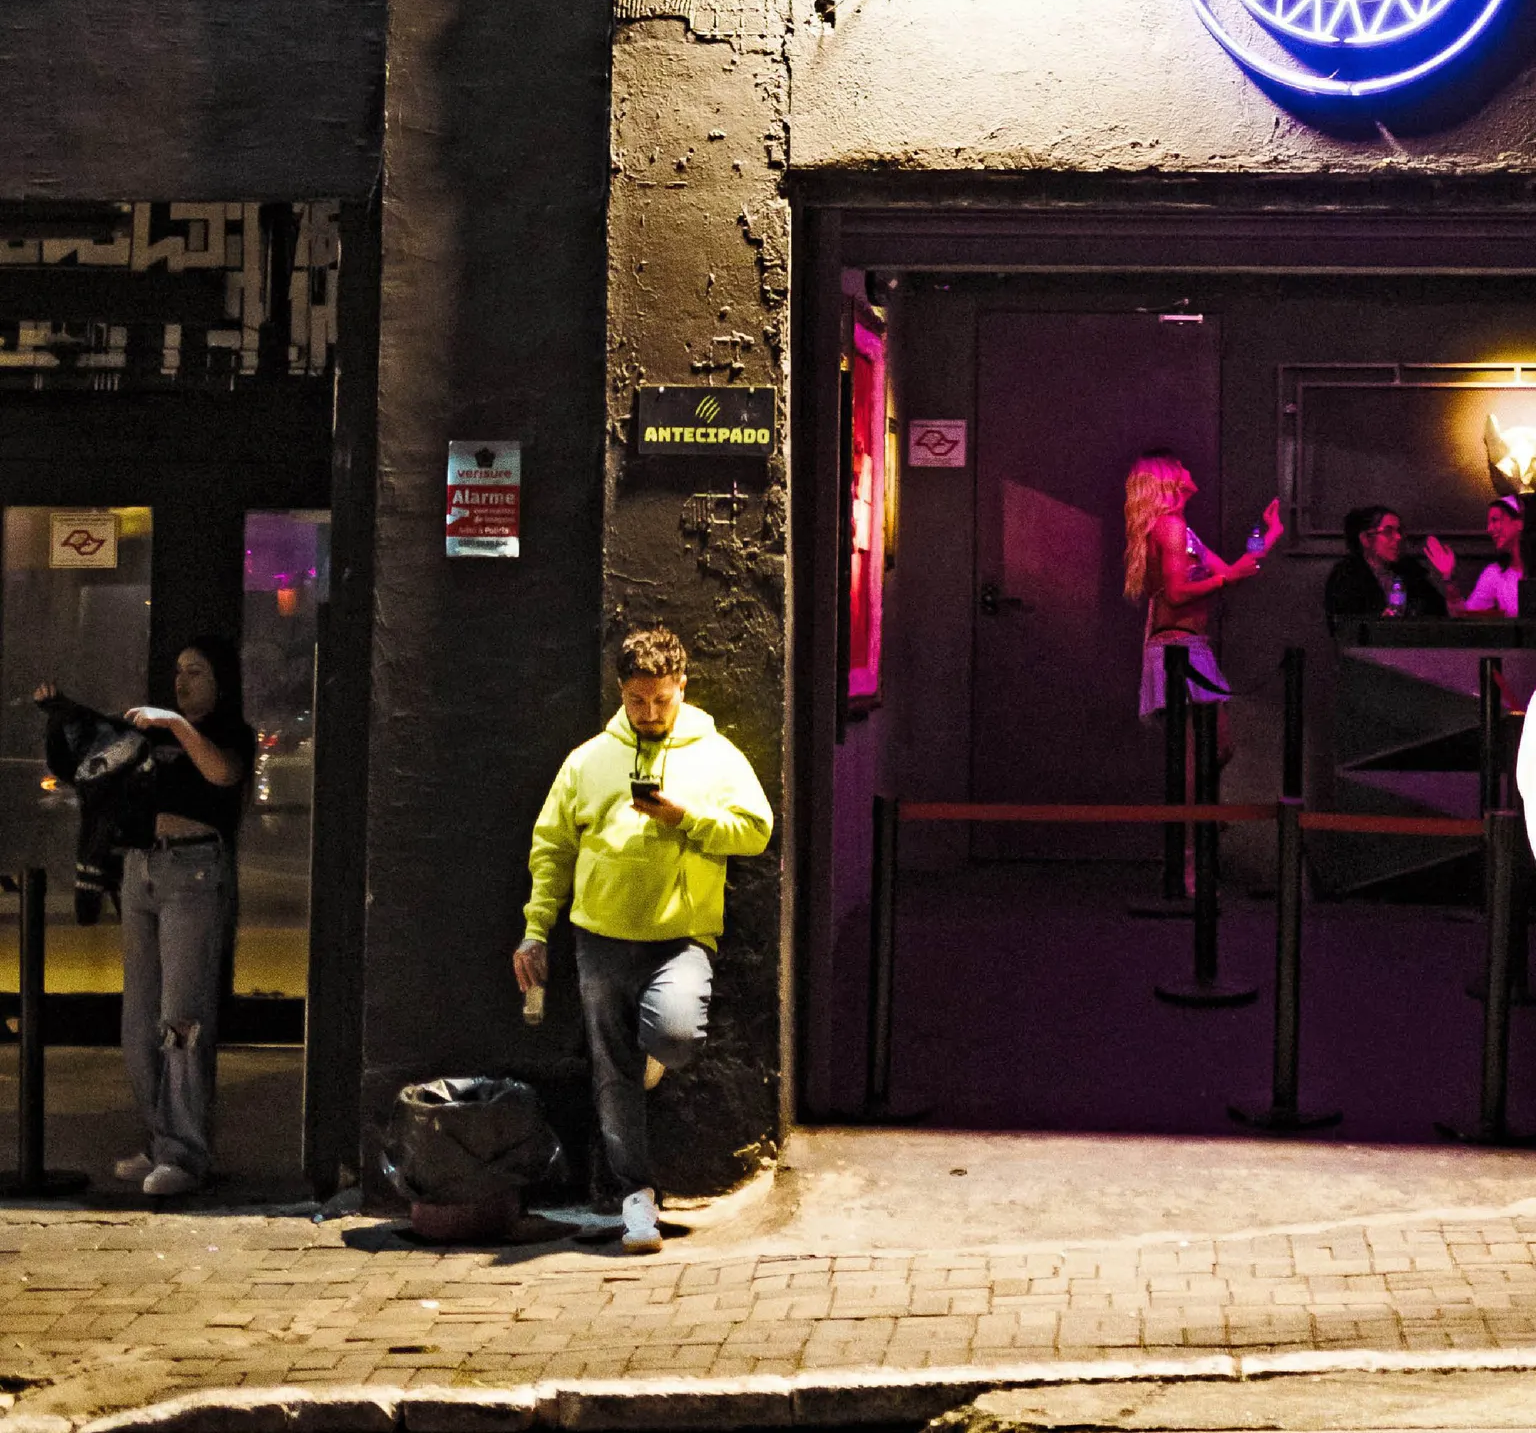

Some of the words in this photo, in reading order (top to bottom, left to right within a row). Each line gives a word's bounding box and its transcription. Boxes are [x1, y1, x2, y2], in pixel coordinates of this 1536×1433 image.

[644, 426, 770, 444] ANTECIPADO
[457, 469, 512, 479] verisure
[452, 488, 516, 505] Alarme
